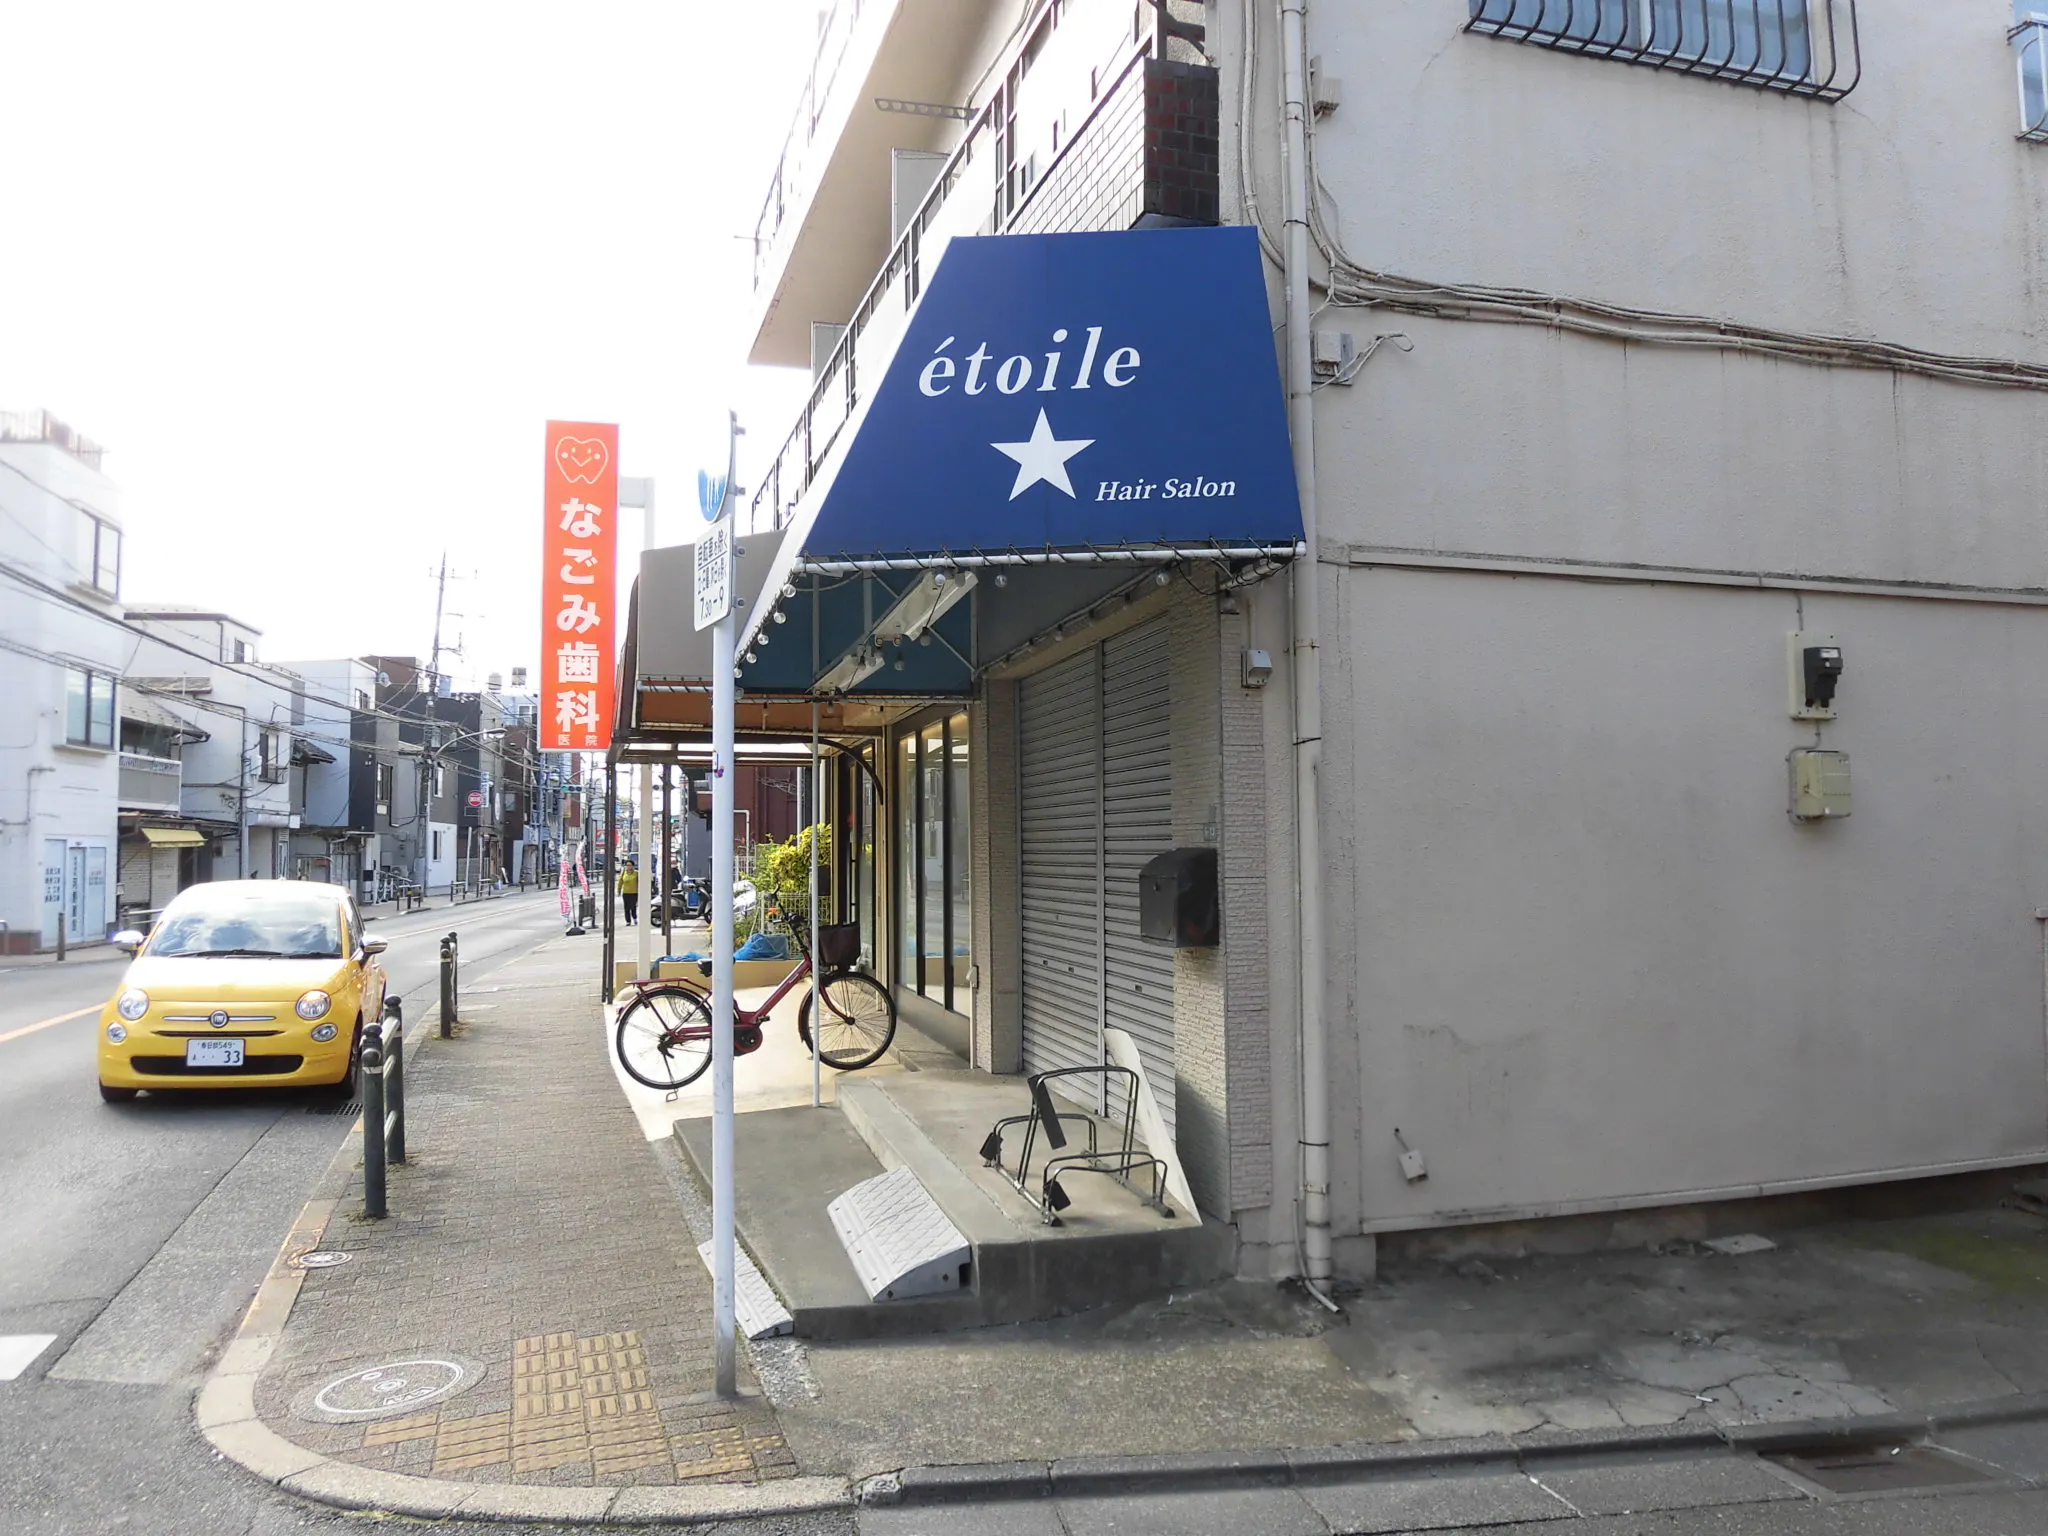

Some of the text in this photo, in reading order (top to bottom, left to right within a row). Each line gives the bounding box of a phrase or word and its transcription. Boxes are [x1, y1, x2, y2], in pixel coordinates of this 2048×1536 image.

[918, 326, 1141, 397] étoile
[1095, 476, 1237, 502] Hair Salon
[555, 497, 602, 732] なごみ歯科
[224, 1050, 240, 1064] 33
